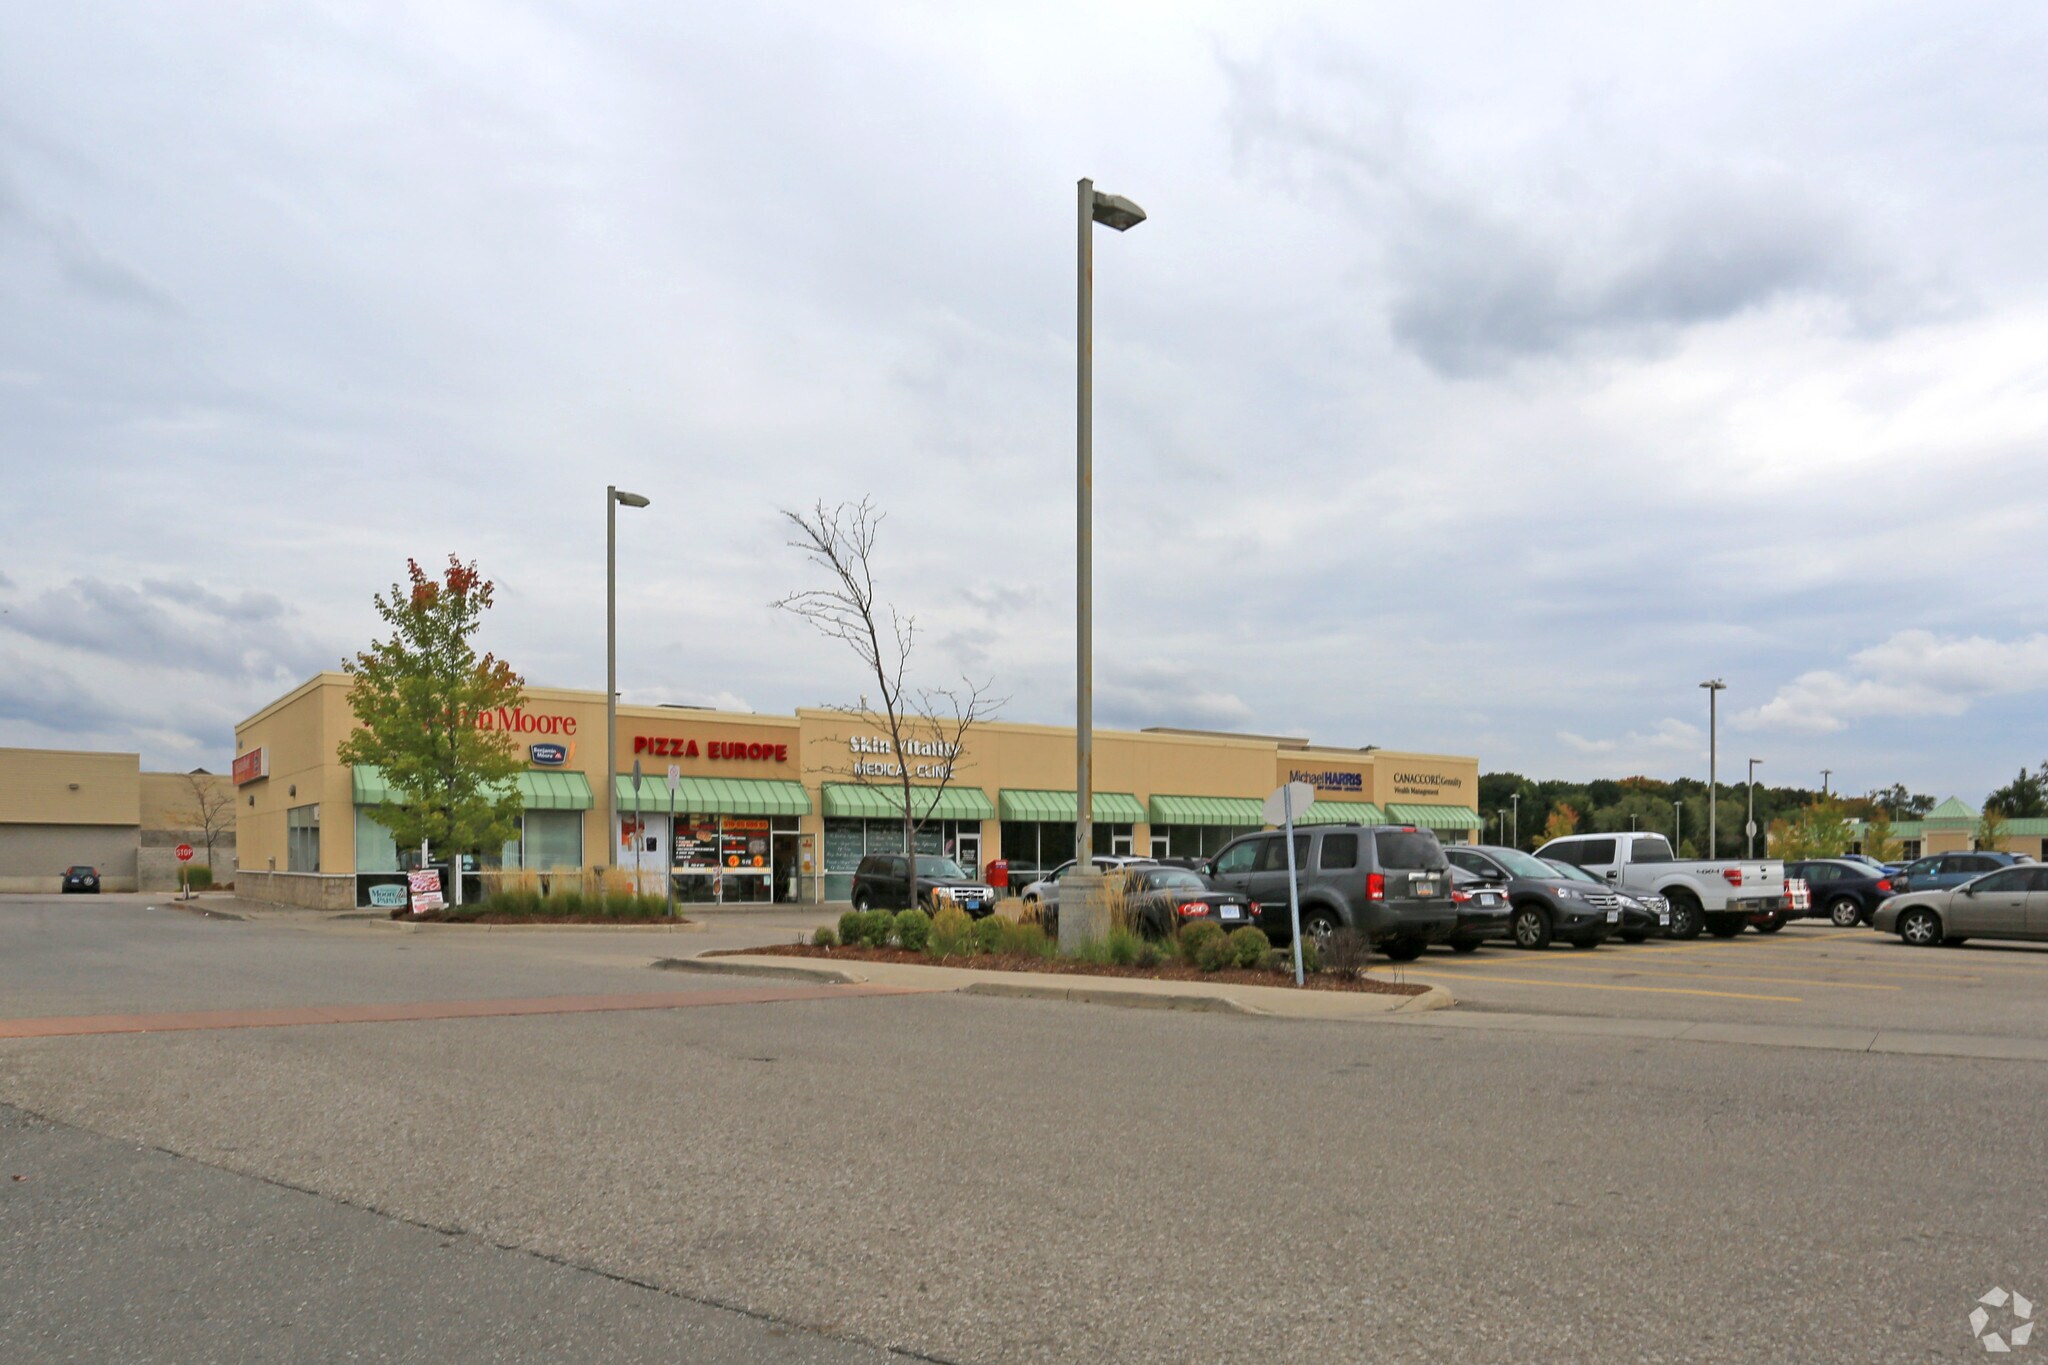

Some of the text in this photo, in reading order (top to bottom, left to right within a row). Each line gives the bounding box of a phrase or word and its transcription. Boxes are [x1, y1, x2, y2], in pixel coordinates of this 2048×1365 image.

[498, 706, 577, 736] Moore
[634, 736, 788, 761] PIZZA EUROPE
[850, 736, 891, 754] Skin
[176, 848, 193, 856] STOP
